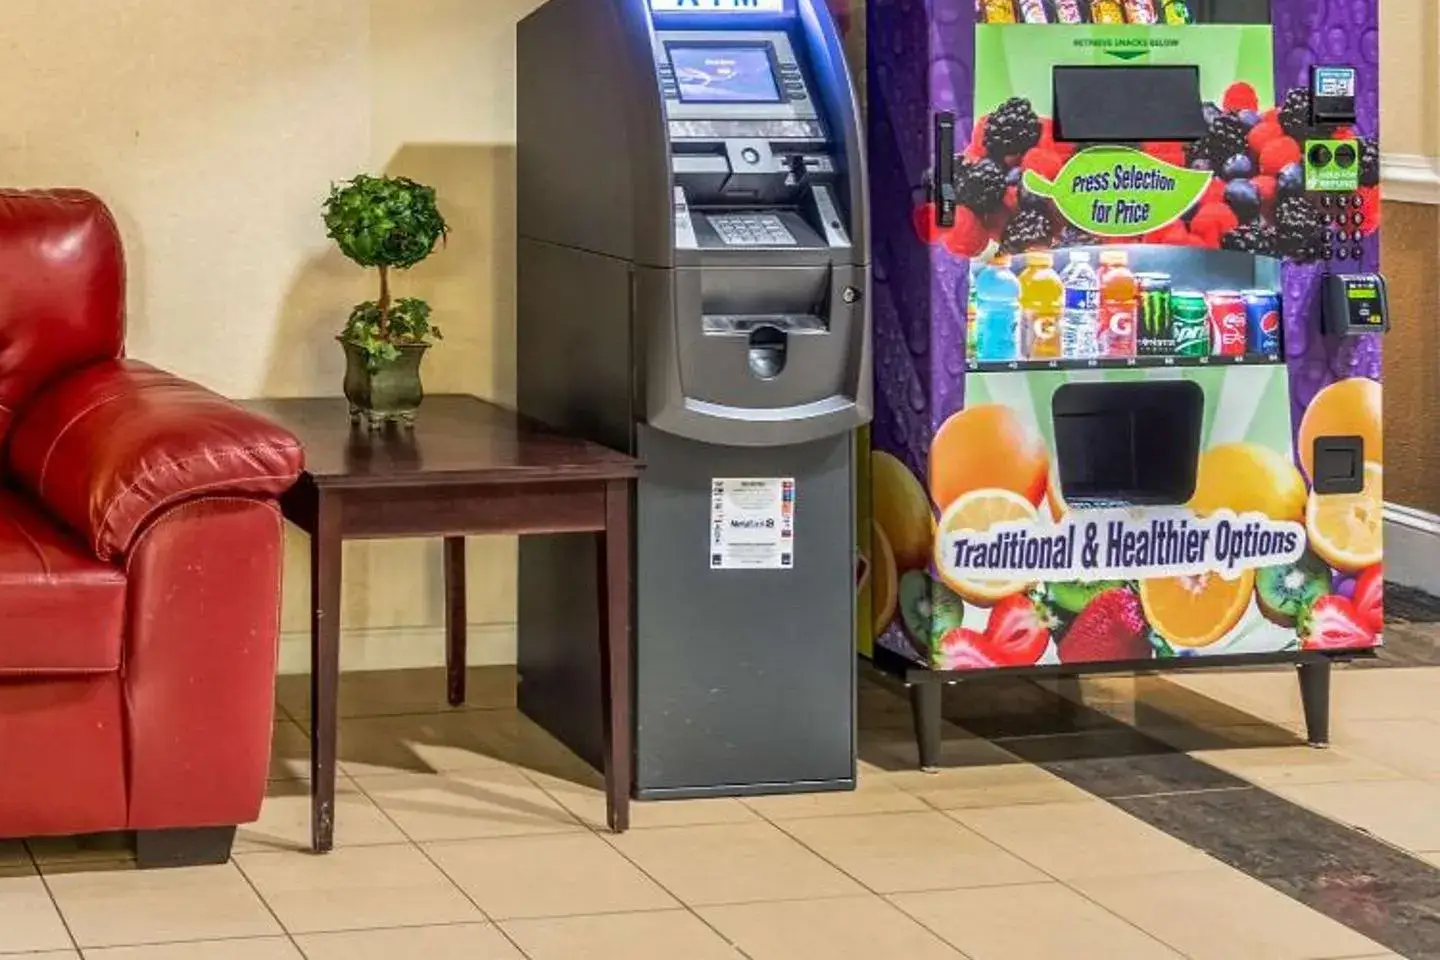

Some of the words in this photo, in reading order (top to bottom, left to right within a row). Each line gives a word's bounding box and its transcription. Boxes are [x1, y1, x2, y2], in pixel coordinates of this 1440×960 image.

[1072, 172, 1110, 193] Press
[1113, 164, 1176, 191] Selection
[1092, 199, 1112, 223] for
[1115, 199, 1150, 224] Price
[1110, 313, 1133, 335] G
[954, 525, 1073, 569] Traditional
[1081, 522, 1098, 568] &
[1105, 519, 1210, 568] Healthier
[1214, 519, 1297, 568] Options
